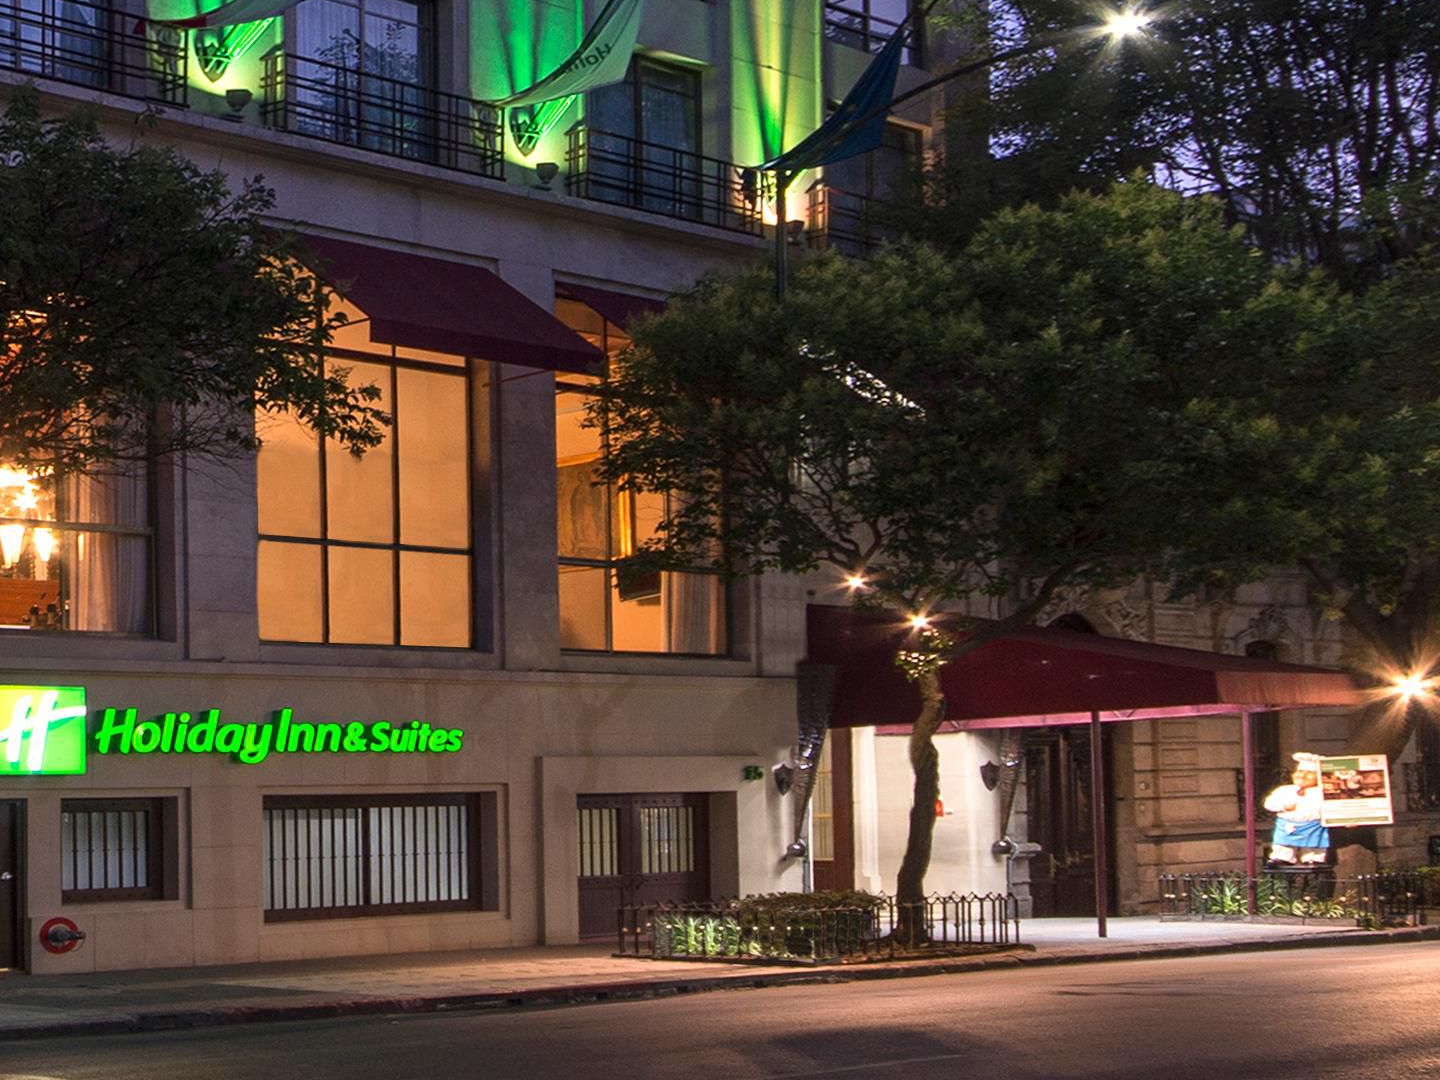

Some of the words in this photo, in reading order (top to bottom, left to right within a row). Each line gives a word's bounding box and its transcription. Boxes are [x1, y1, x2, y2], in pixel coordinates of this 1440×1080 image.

[95, 707, 273, 764] Holiday
[275, 707, 342, 753] Inn
[343, 721, 368, 753] &
[369, 721, 464, 753] Suites
